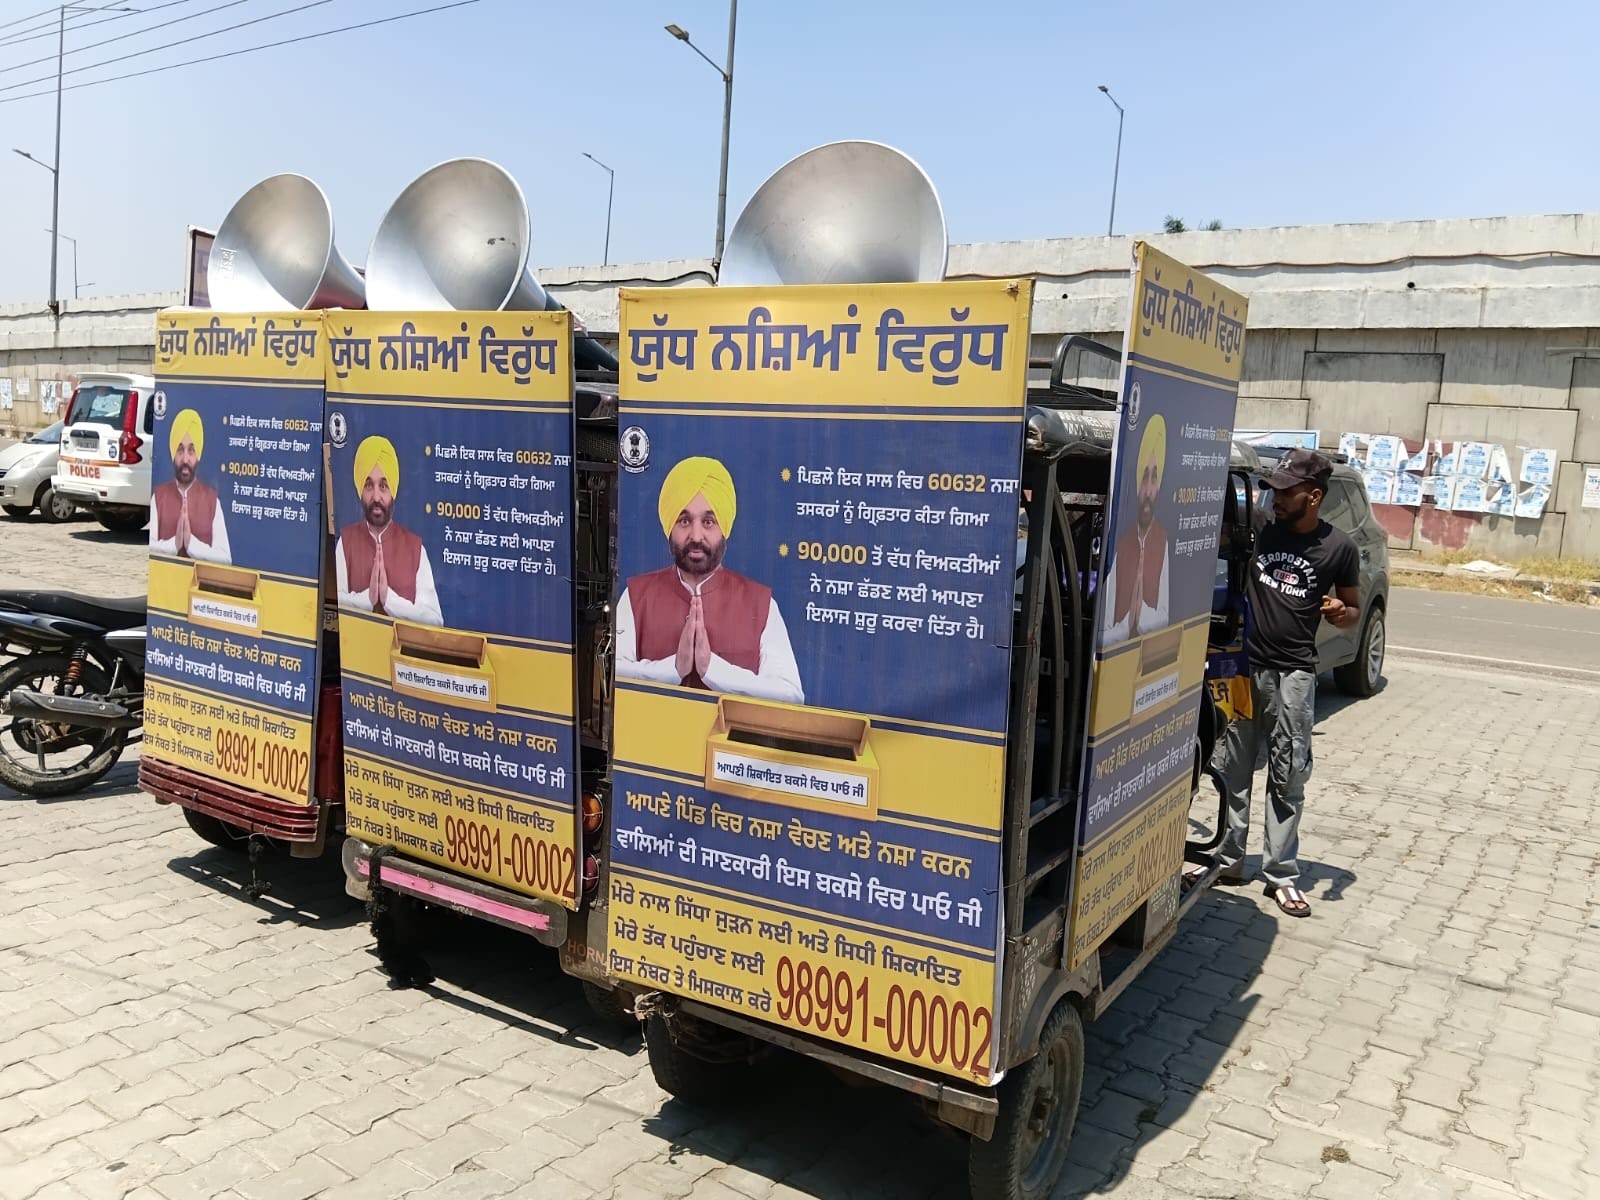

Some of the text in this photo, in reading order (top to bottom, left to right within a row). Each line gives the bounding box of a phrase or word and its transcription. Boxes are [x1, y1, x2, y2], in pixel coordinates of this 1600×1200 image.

[158, 316, 317, 366] ਯੁੱਧ ਨਸ਼ਿਆਂ ਵਿਰੁੱਧ
[327, 321, 558, 385] ਯੁੱਧ ਨਸ਼ਿਆਂ ਵਿਰੁੱਧ
[627, 304, 1008, 385] ਯੁੱਧ ਨਸ਼ਿਆਂ ਵਿਰੁੱਧ
[70, 465, 101, 479] POLICE
[228, 461, 258, 476] 90,000
[515, 450, 551, 464] 60632
[797, 465, 1018, 493] ਪਿਛਲੇ ਇਕ ਸਾਲ ਵਿਚ 60632 ਨਸ਼ਾ
[436, 501, 480, 519] 90,000
[796, 499, 840, 517] ਤਸਕਰਾਂ
[842, 499, 854, 523] ਨੂੰ
[914, 504, 945, 524] ਕੀਤਾ
[949, 506, 989, 526] ਗਿਆ
[798, 541, 1000, 575] 90,000 ਤੋਂ ਵੱਧ ਵਿਅਕਤੀਆਂ
[1256, 552, 1317, 589] AEROPOSTALE
[809, 572, 983, 607] ਨੇ ਨਸ਼ਾ ਛੱਡਣ ਲਈ ਆਪਣਾ
[1259, 573, 1308, 599] NEW YORK
[805, 601, 850, 624] ਇਲਾਜ
[853, 611, 878, 633] ਸ਼ੁਰੂ
[881, 614, 923, 632] ਕਰਵਾ
[927, 613, 962, 635] ਦਿੱਤਾ
[216, 727, 308, 796] 98991-00002
[625, 790, 972, 879] ਆਪਣੇ ਪਿੰਡ ਵਿਚ ਨਸ਼ਾ ਵੇਚਣ ਅਤੇ ਨਸ਼ਾ ਕਰਨ
[444, 814, 575, 903] 98991-00002
[616, 825, 982, 927] ਵਾਲਿਆਂ ਦੀ ਜਾਣਕਾਰੀ ਇਸ ਬਕਸੇ ਵਿਚ ਪਾਓ ਜੀ
[610, 878, 961, 986] ਮੇਰੇ ਨਾਲ ਸਿੱਧਾ ਜੁੜਨ ਲਈ ਅਤੇ ਸਿਧੀ ਸ਼ਿਕਾਇਤ
[614, 915, 765, 975] ਮੇਰੇ ਤੱਕ ਪਹੁੰਚਾਣ ਲਈ
[567, 939, 605, 963] HORN
[608, 948, 772, 1012] ਇਸ ਨੰਬਰ ਤੇ ਮਿਸਕਾਲ ਕਰੋ
[776, 955, 994, 1077] 98991-00002
